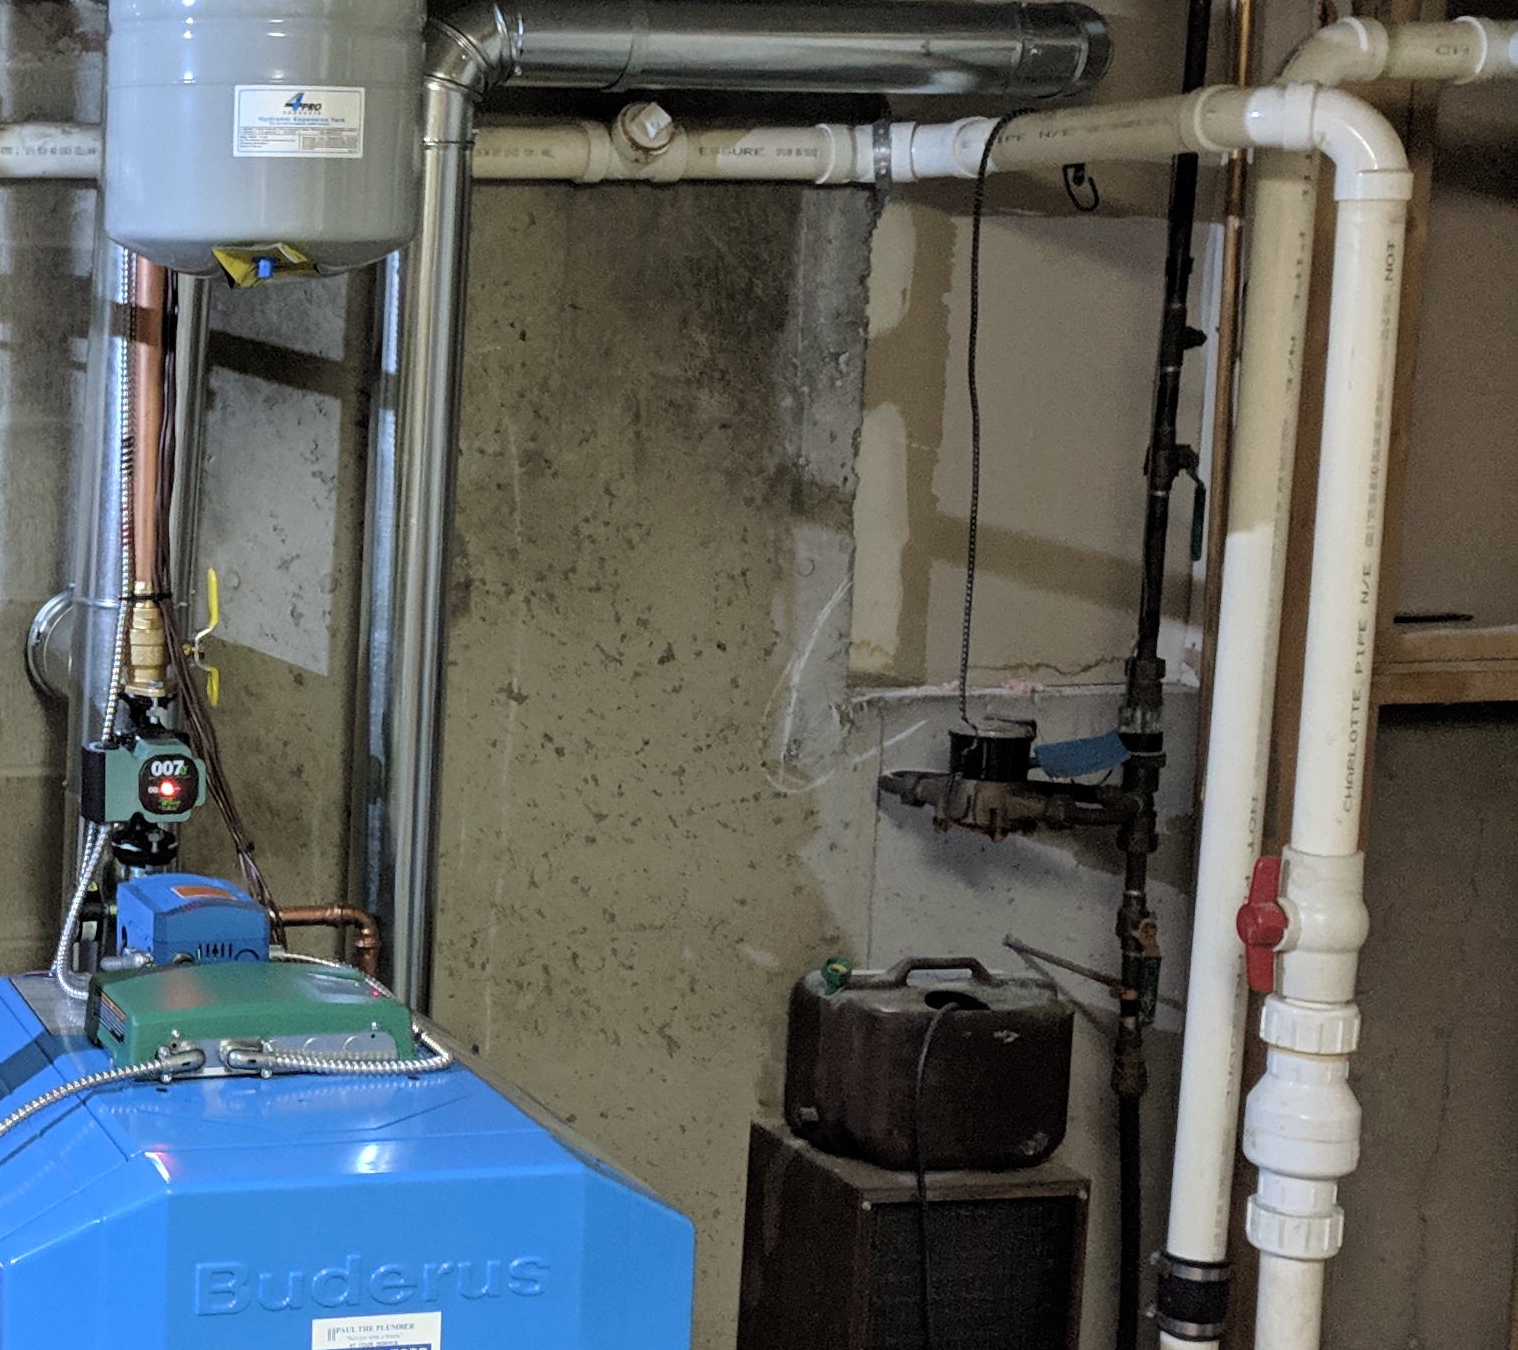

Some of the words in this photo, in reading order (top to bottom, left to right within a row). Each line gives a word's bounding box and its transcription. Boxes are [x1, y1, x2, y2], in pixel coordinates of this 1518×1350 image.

[1383, 241, 1397, 283] NOT
[1343, 687, 1363, 813] CHARLOTTE
[1353, 618, 1369, 674] PIPE
[194, 1252, 552, 1318] Buderus
[358, 1325, 373, 1333] THE
[376, 1323, 415, 1331] PLUMBER
